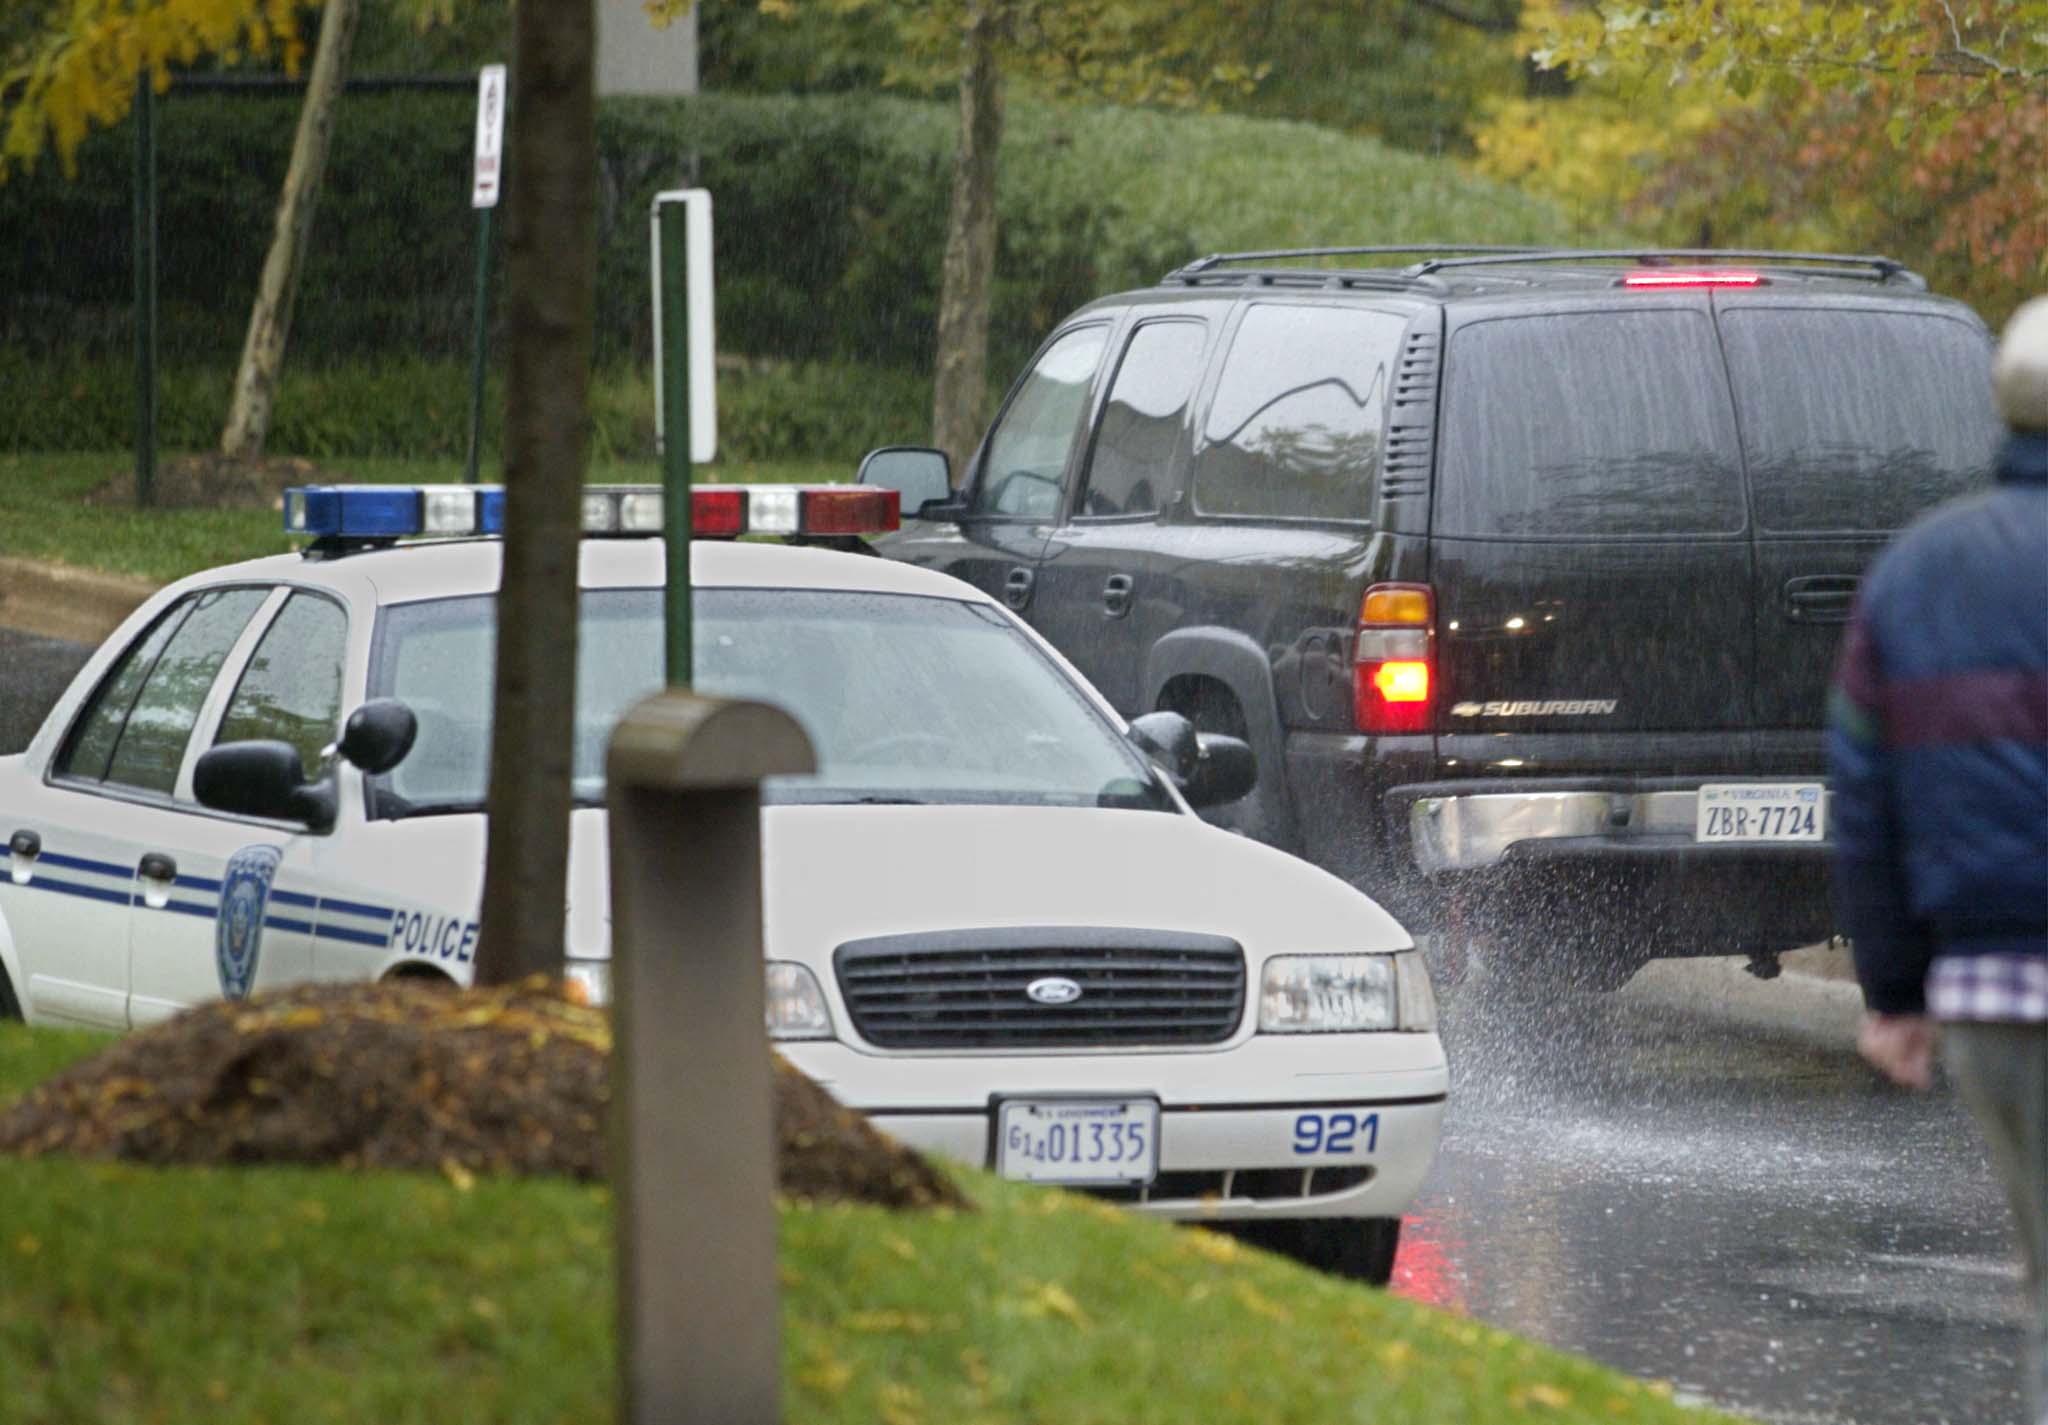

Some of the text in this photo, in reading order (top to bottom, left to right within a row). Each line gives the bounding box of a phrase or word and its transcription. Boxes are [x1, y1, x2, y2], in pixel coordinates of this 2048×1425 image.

[1482, 699, 1618, 716] SUBURBAN
[1706, 805, 1816, 836] ZBR-7724
[389, 910, 480, 962] POLICE
[1292, 1113, 1379, 1154] 921
